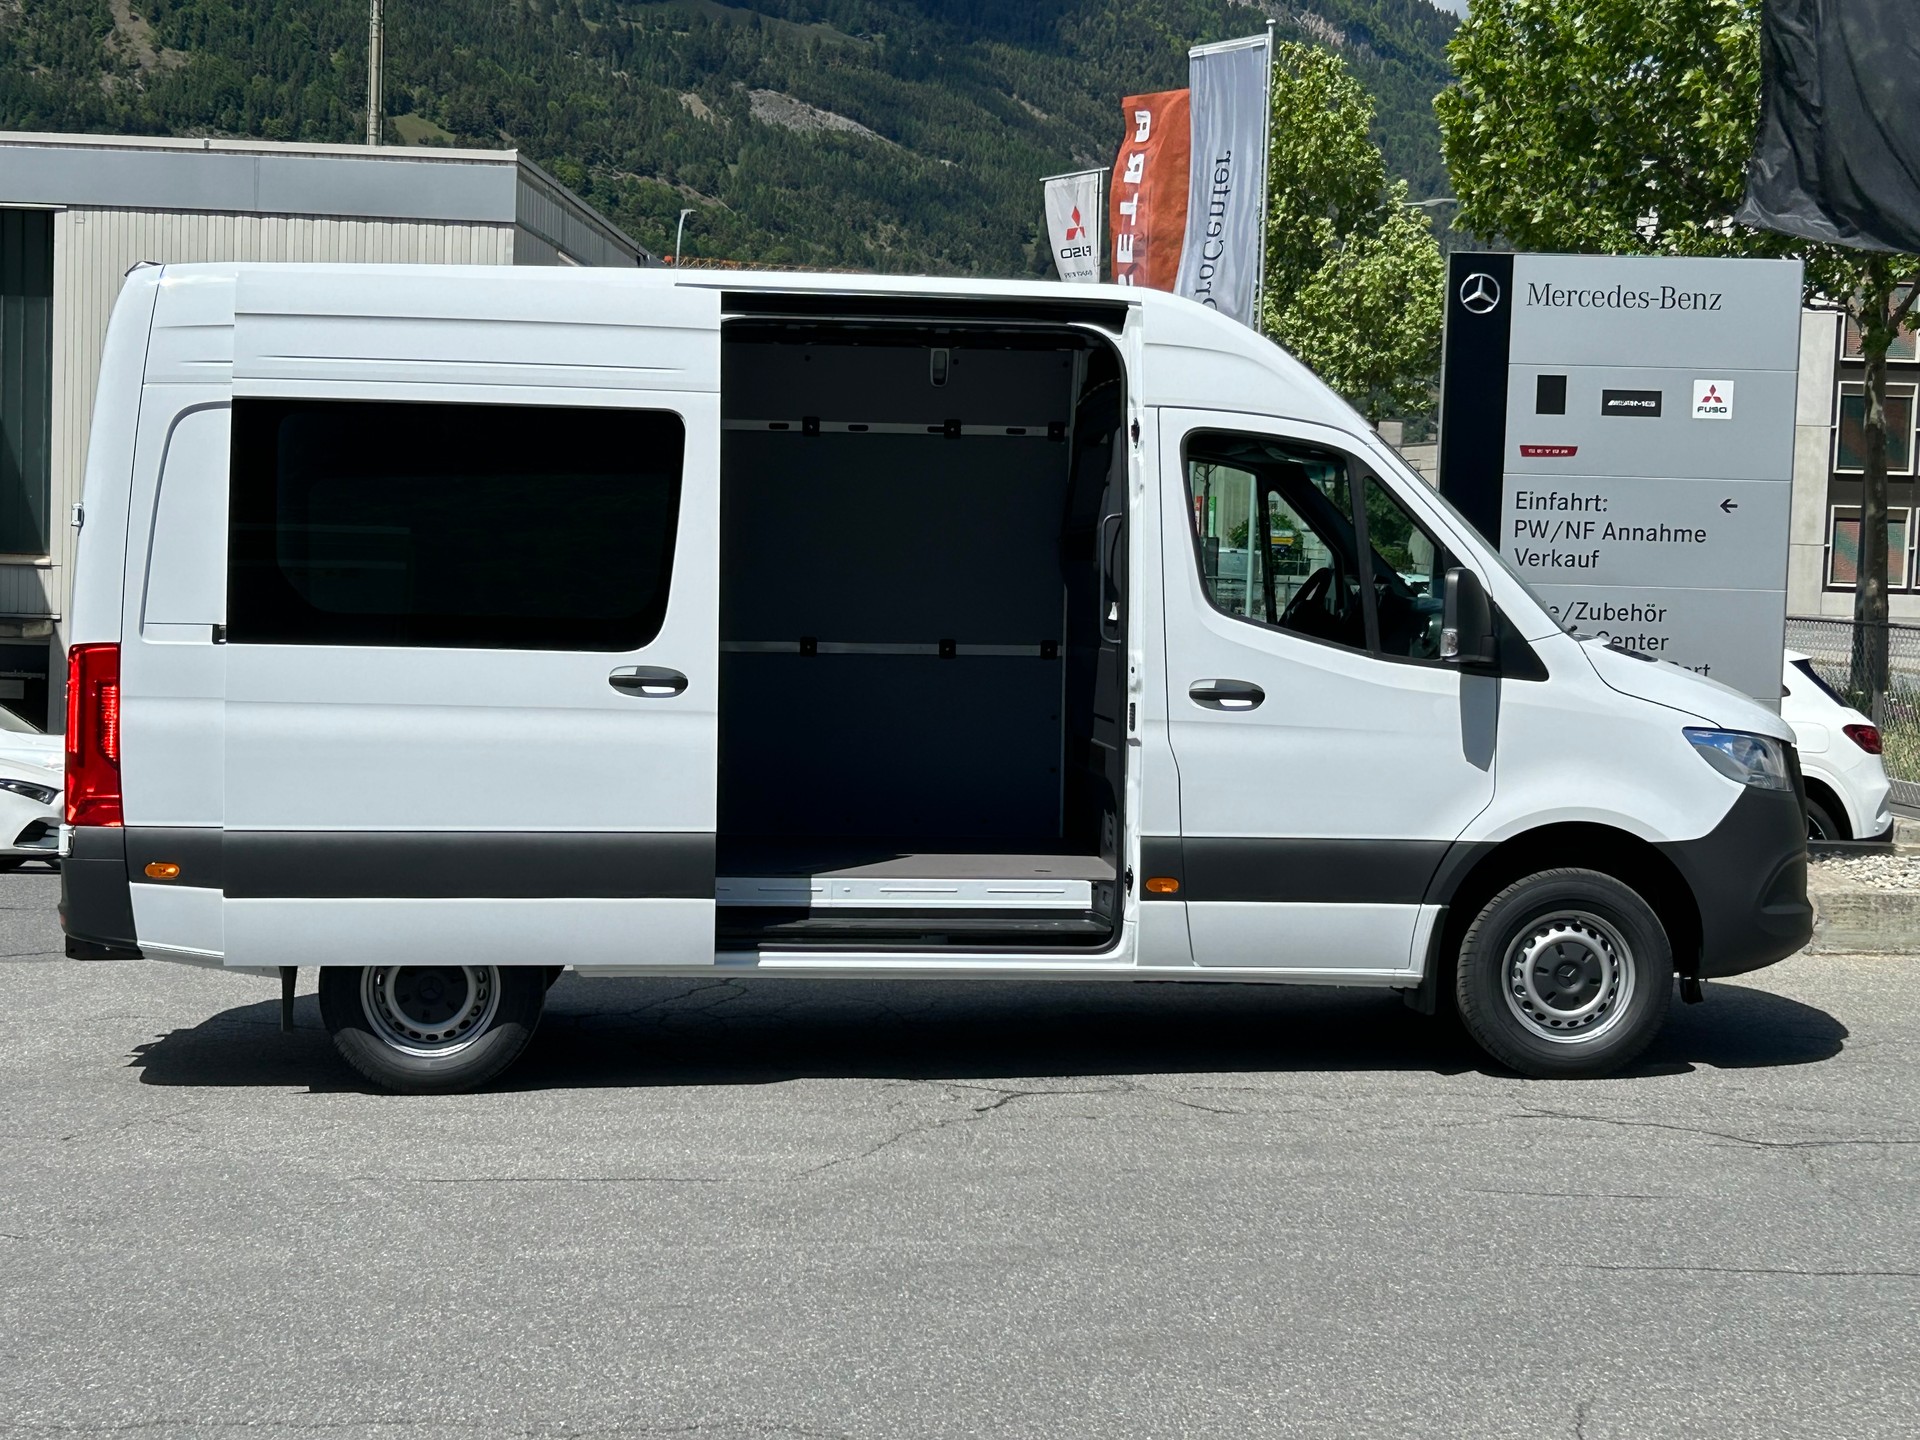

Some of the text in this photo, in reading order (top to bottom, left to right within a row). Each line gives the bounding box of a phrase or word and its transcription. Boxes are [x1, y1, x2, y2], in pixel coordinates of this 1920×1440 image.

[1526, 282, 1722, 311] Mercedes-Benz
[1515, 491, 1608, 512] Einfahrt:
[1514, 519, 1707, 544] PW/NF Annahme
[1514, 548, 1600, 568] Verkauf
